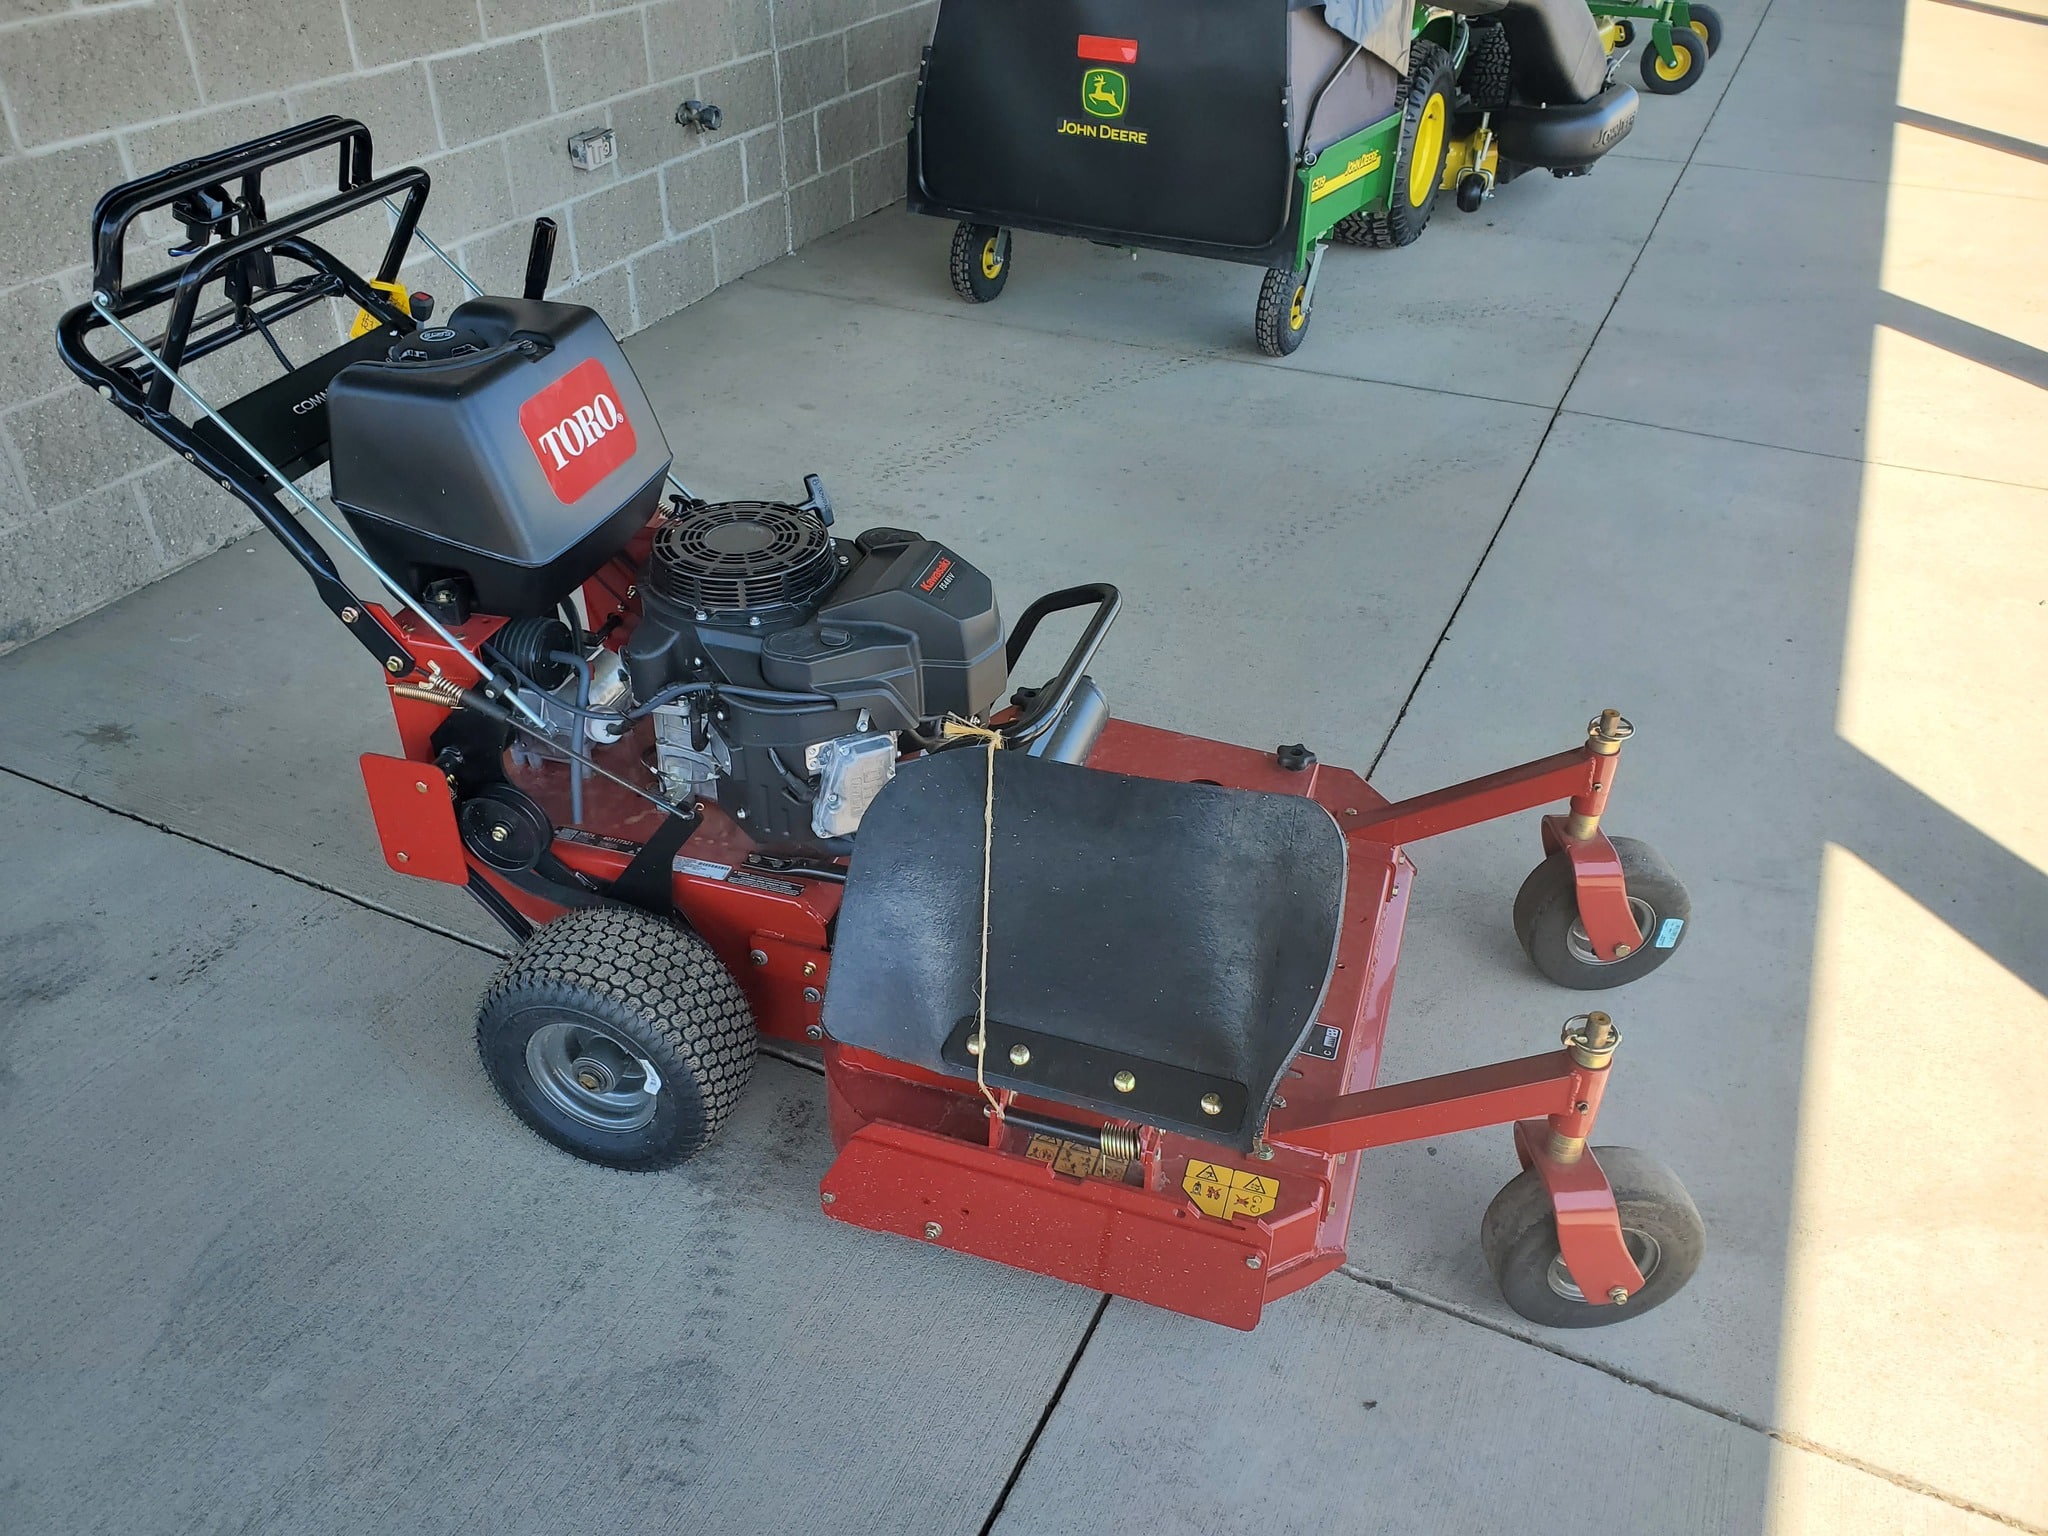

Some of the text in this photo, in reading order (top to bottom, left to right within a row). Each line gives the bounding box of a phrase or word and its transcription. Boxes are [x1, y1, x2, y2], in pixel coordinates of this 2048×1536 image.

[1058, 119, 1148, 144] JOHN DEERE
[920, 557, 952, 592] Kawasaki
